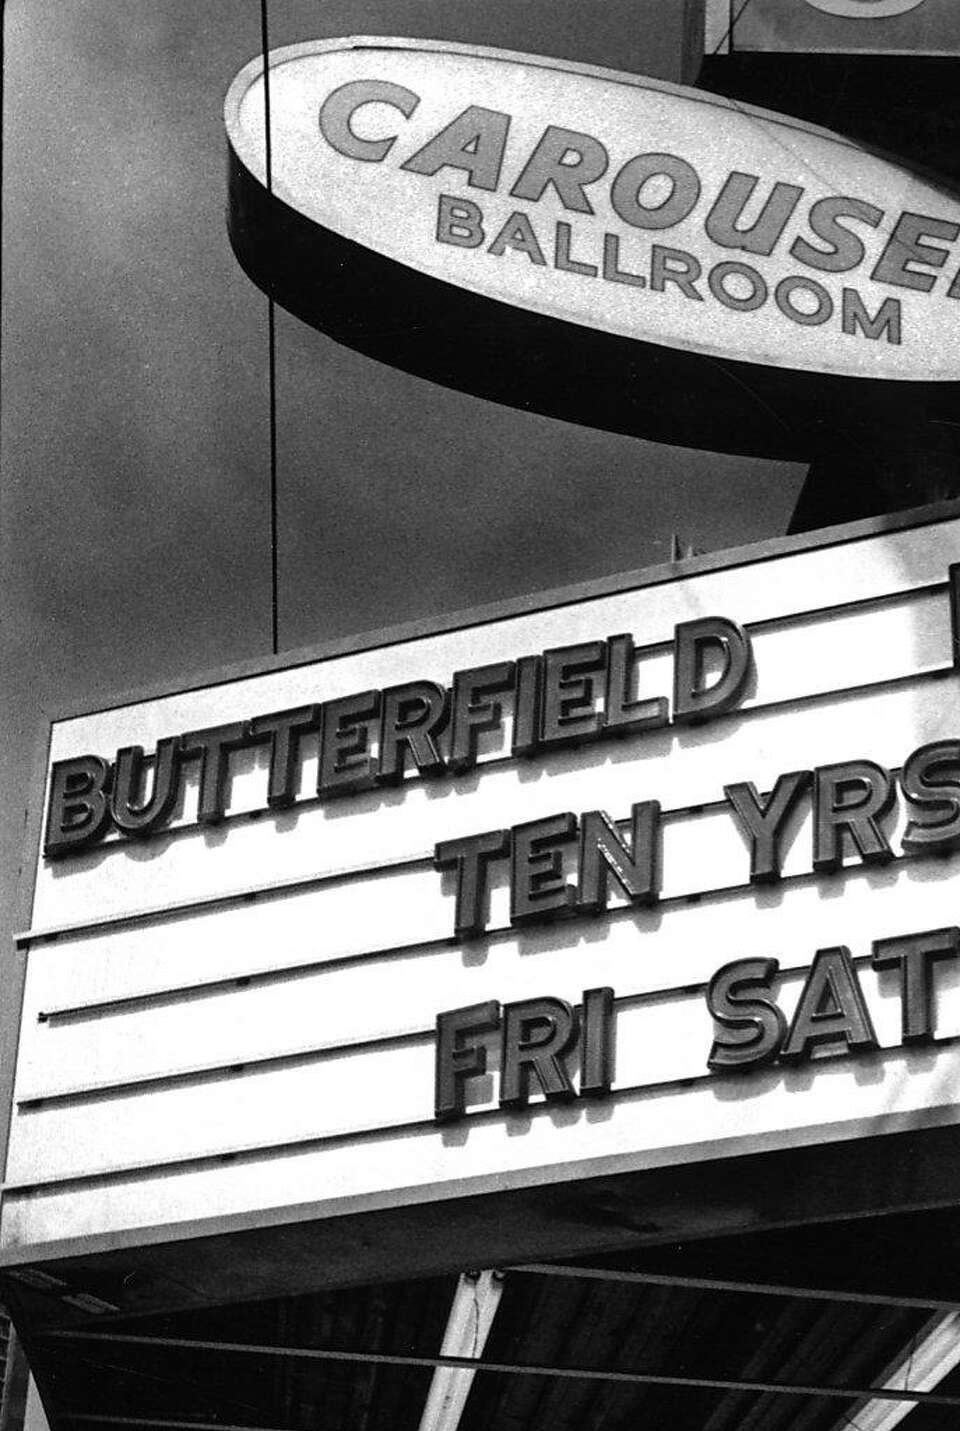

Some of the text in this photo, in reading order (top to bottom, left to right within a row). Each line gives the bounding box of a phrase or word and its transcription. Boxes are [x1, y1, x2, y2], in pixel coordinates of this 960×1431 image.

[434, 194, 903, 345] BALLROOM
[44, 616, 753, 859] BUTTERFIELD
[434, 799, 662, 940] TEN
[434, 986, 617, 1122] FRI
